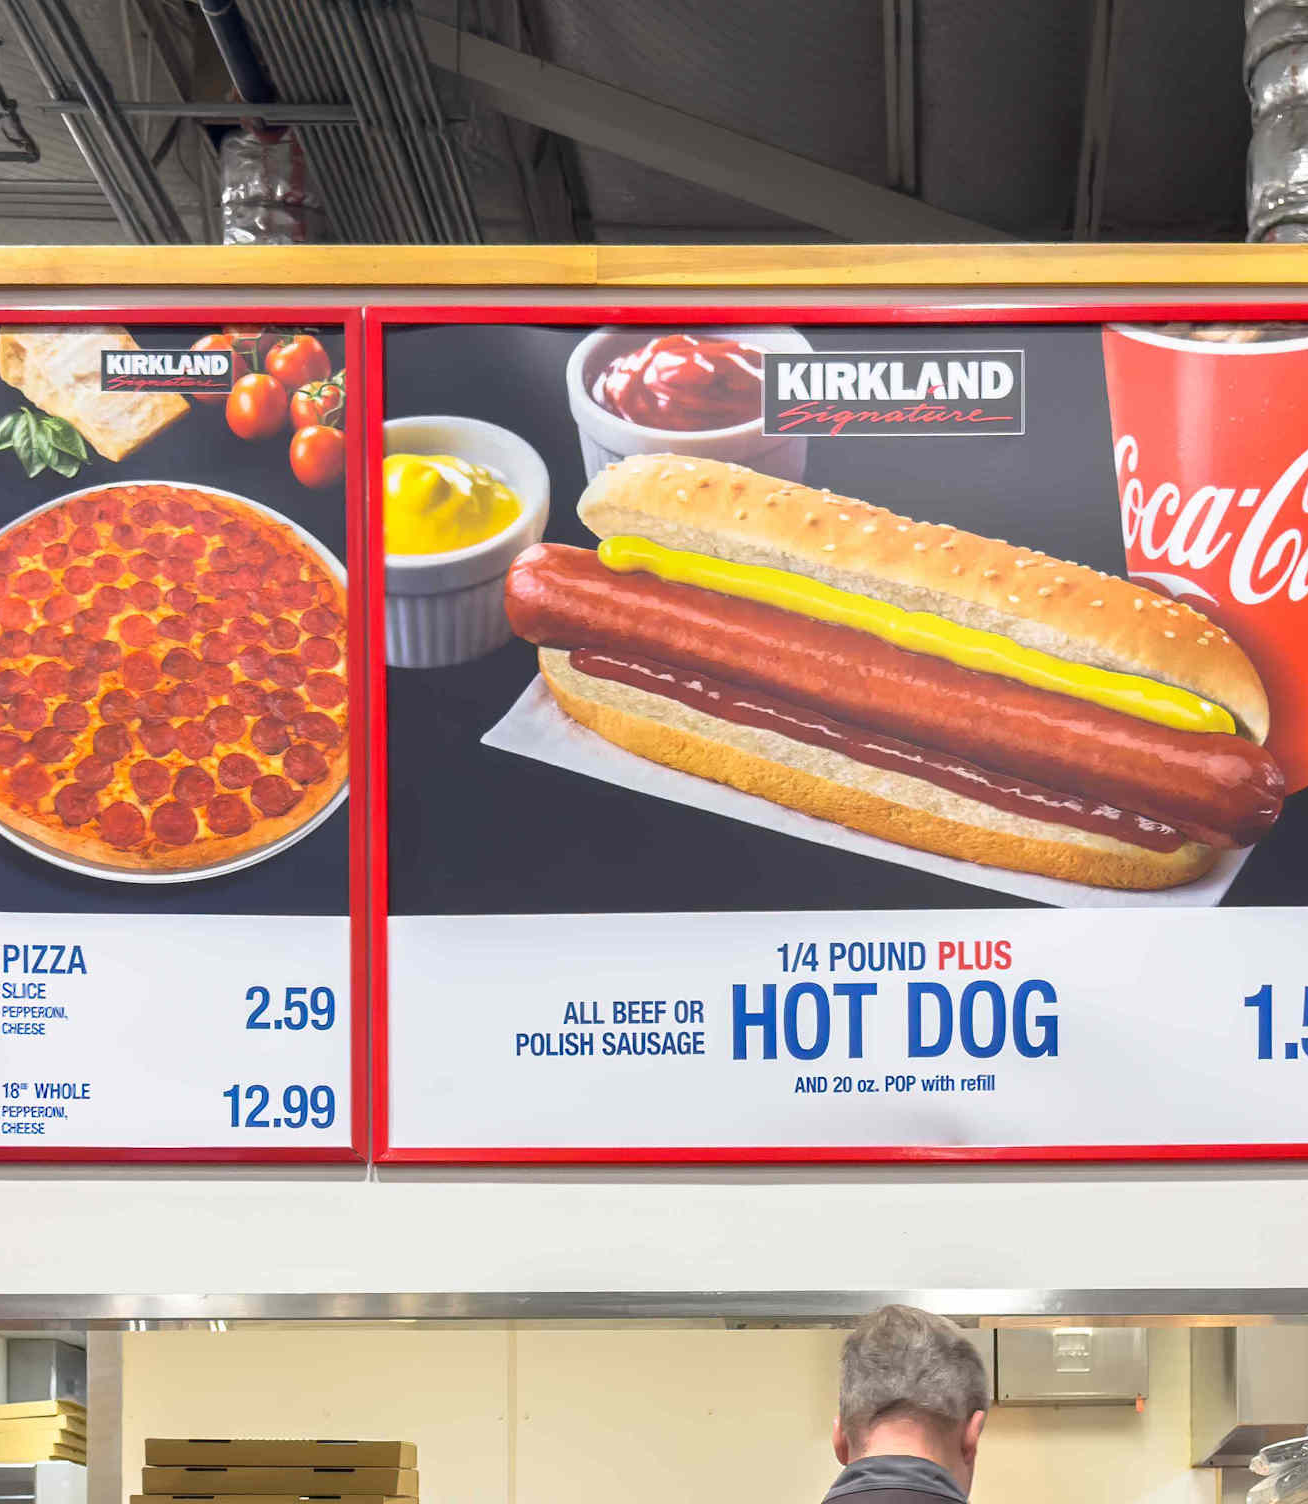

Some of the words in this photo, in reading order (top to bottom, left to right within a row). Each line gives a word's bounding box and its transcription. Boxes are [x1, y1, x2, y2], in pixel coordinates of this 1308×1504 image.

[106, 354, 229, 376] KIRKLAND
[778, 360, 1014, 403] KIRKLAND
[780, 402, 1013, 436] Signature
[3, 944, 87, 974] PIZZA
[777, 943, 819, 972] 1/4
[830, 942, 925, 972] POUND
[939, 941, 1011, 970] PLUS
[2, 982, 45, 999] SLICE
[246, 986, 335, 1030] 2.59
[563, 1001, 605, 1024] ALL
[613, 1001, 666, 1024] BEEF
[674, 1000, 704, 1024] OR
[733, 982, 877, 1060] HOT
[907, 980, 1058, 1058] DOG
[2, 1023, 45, 1035] CHEESE
[516, 1033, 593, 1056] POLISH
[602, 1032, 705, 1056] SAUSAGE
[34, 1083, 90, 1099] WHOLE
[795, 1077, 827, 1093] AND
[833, 1076, 852, 1093] 20
[857, 1080, 879, 1093] oz.
[885, 1076, 916, 1092] POP
[922, 1075, 955, 1092] with
[961, 1075, 995, 1091] refill
[223, 1084, 335, 1129] 12.99
[2, 1122, 45, 1134] CHEESE
